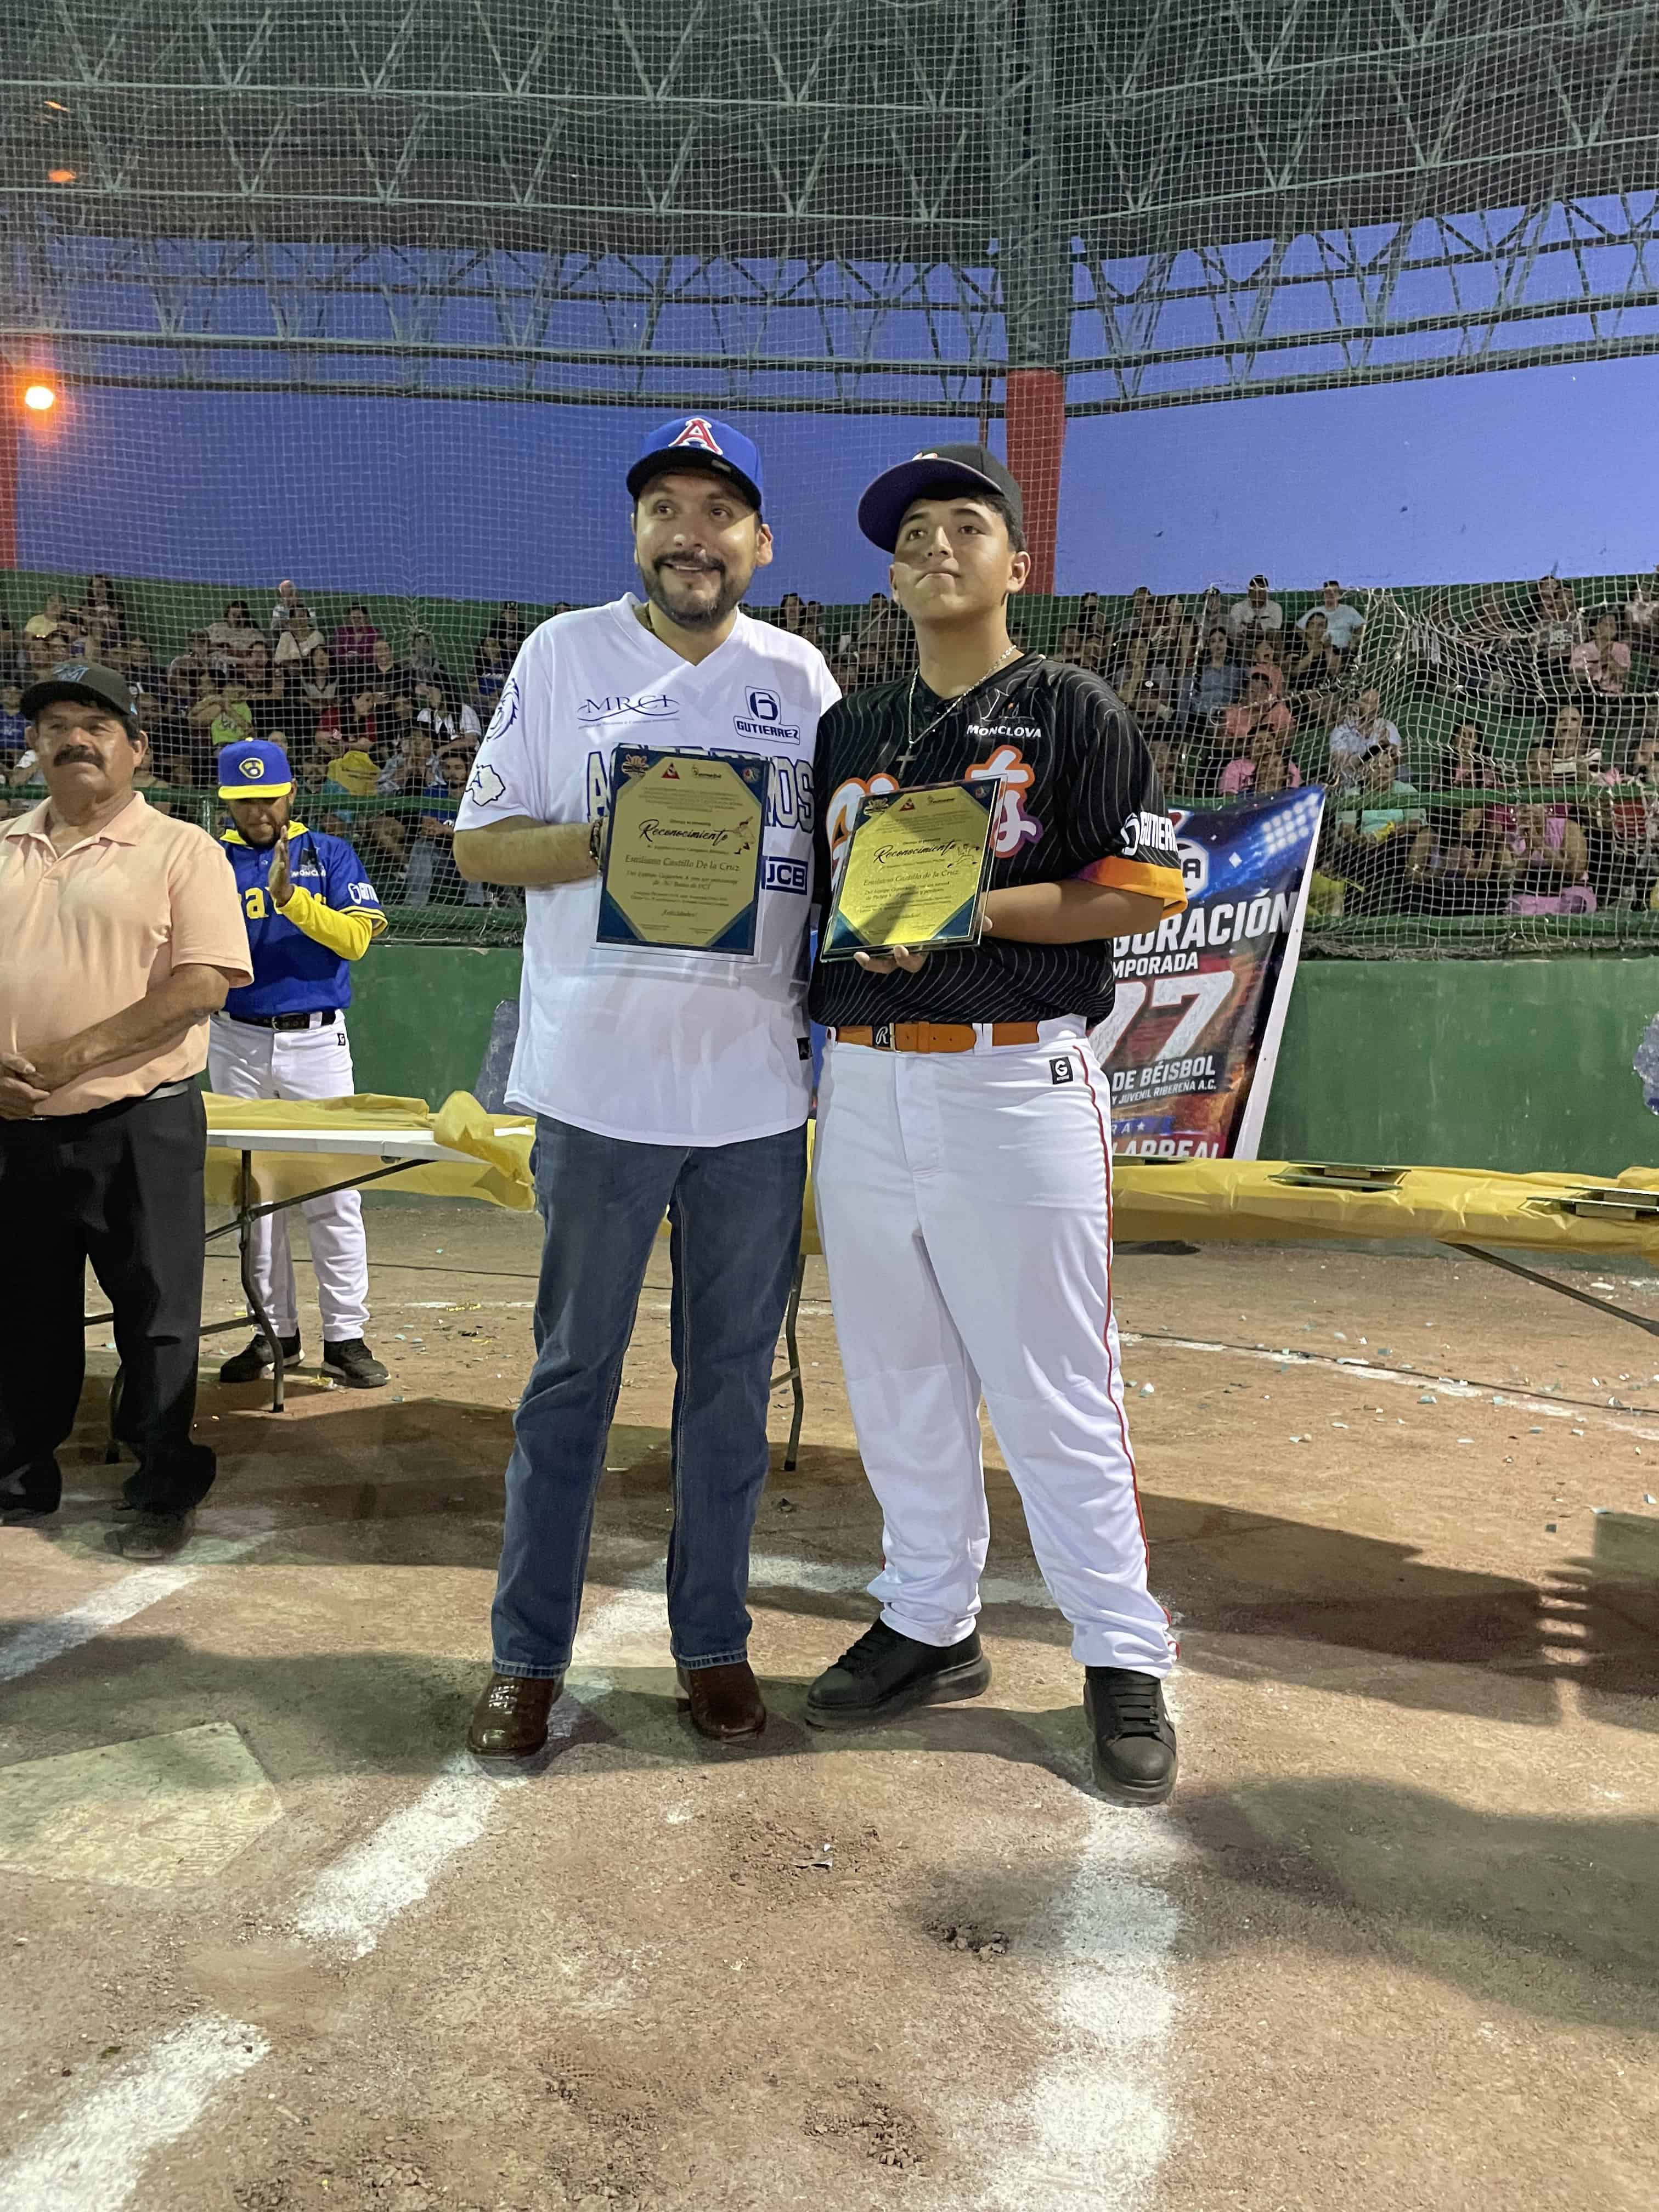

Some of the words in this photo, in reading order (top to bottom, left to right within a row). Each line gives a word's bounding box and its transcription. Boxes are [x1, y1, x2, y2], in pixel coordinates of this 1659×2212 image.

[668, 418, 723, 455] A
[585, 695, 669, 713] MRCI
[736, 720, 799, 740] GUTIERREZ
[967, 724, 1041, 738] MONCLOVA
[639, 819, 729, 846] Reconocimiento
[1139, 812, 1178, 852] GUTIER
[873, 838, 957, 864] Reconocimiento
[720, 862, 740, 871] Cruz
[767, 864, 805, 887] JCB
[1055, 1060, 1068, 1076] G
[1111, 1070, 1137, 1092] DE
[1140, 1055, 1216, 1087] BÉISBOL
[1198, 1079, 1217, 1091] A.C.
